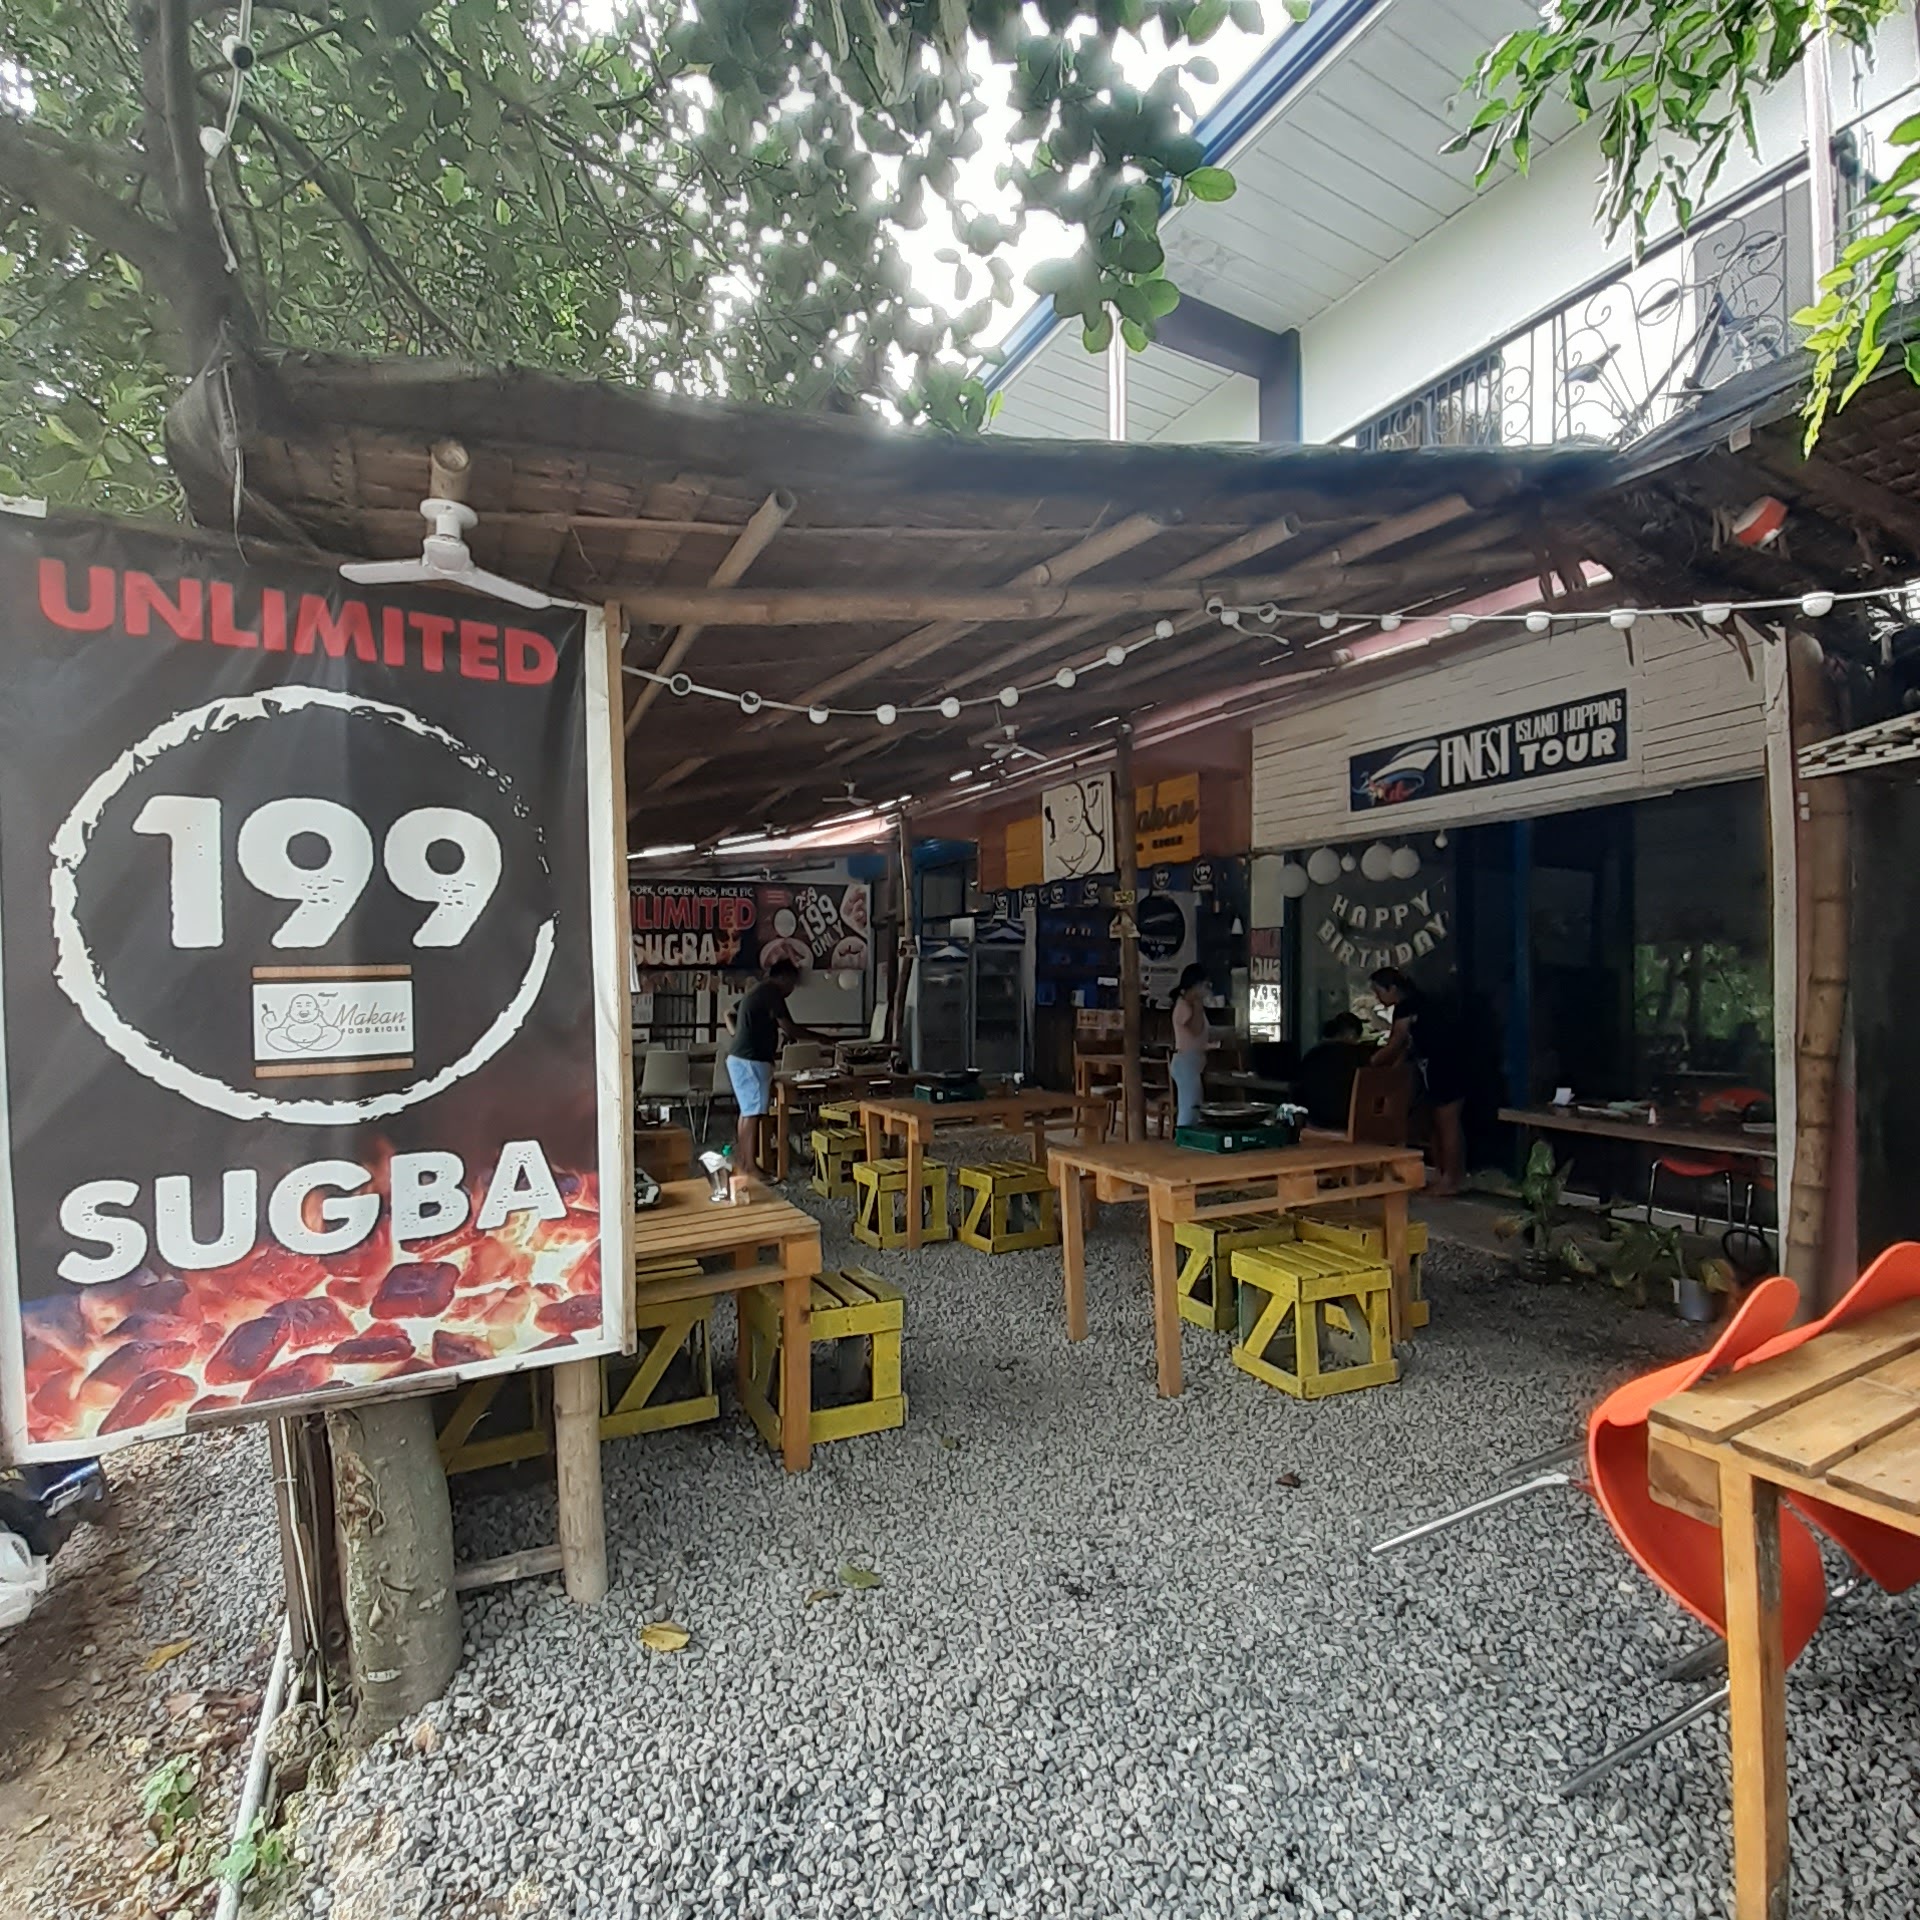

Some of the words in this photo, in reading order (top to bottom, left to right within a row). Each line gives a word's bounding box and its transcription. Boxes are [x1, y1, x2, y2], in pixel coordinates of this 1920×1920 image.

[38, 558, 558, 685] UNLIMITED
[1439, 722, 1512, 787] FINEST
[1515, 711, 1559, 743] ISLAND
[1562, 697, 1622, 733] HOPPING
[1519, 727, 1616, 772] TOUR
[1136, 786, 1198, 833] akan
[132, 795, 502, 948] 199
[632, 895, 757, 930] LIMITED
[798, 894, 839, 941] 199
[1331, 888, 1432, 929] HAPPY
[632, 932, 718, 966] SUGBA
[812, 919, 846, 958] ONLY
[1316, 912, 1448, 969] BIRTHDAY
[332, 1002, 407, 1026] Makan
[374, 1026, 407, 1034] KIOSK
[56, 1139, 568, 1284] SUGBA
